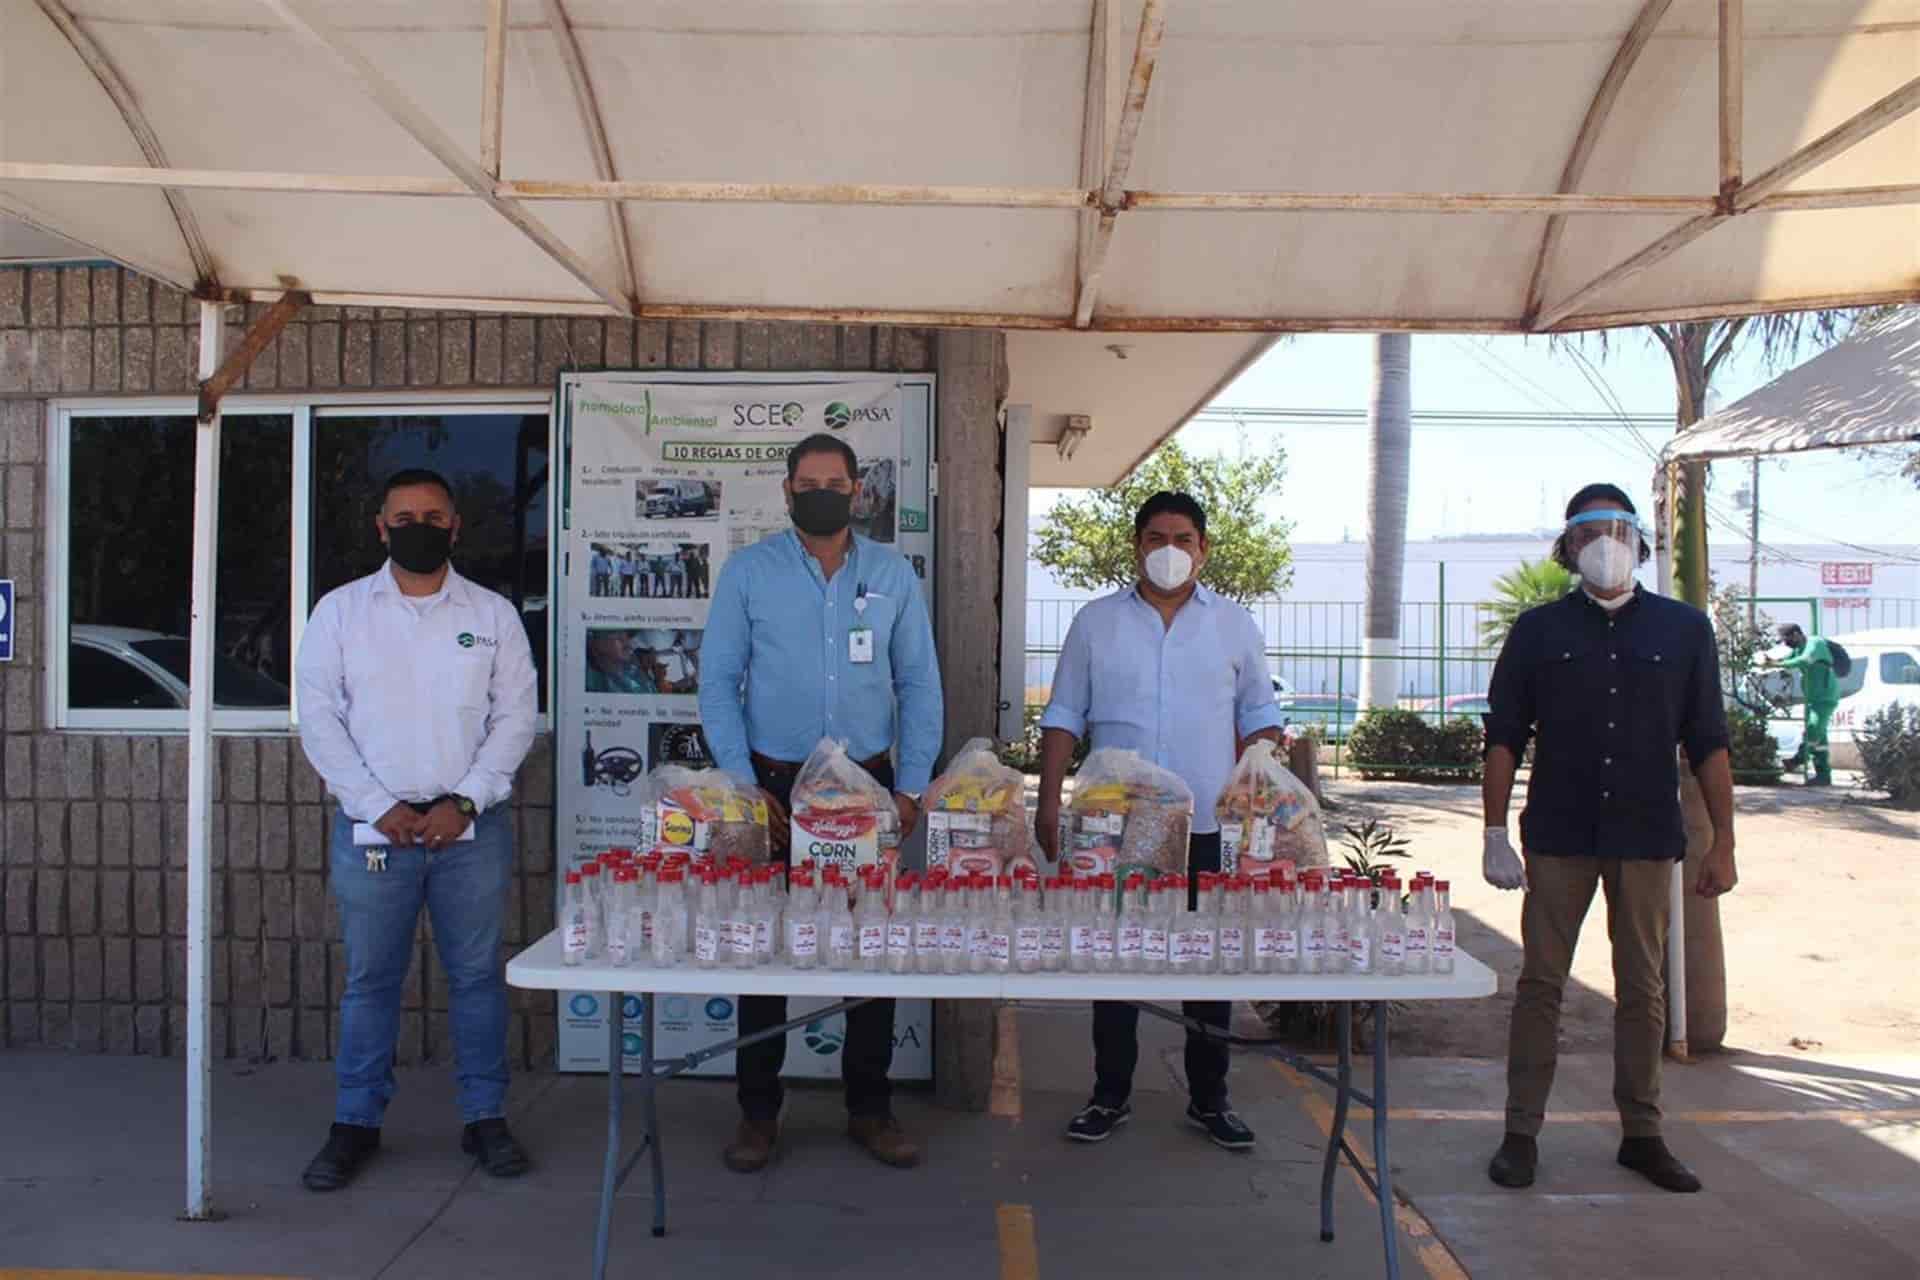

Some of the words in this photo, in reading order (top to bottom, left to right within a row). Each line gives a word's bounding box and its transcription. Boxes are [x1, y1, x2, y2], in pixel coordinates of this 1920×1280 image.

[673, 446, 688, 459] 10
[691, 447, 741, 459] REGLAS
[746, 448, 762, 459] DE
[808, 842, 857, 858] CORN
